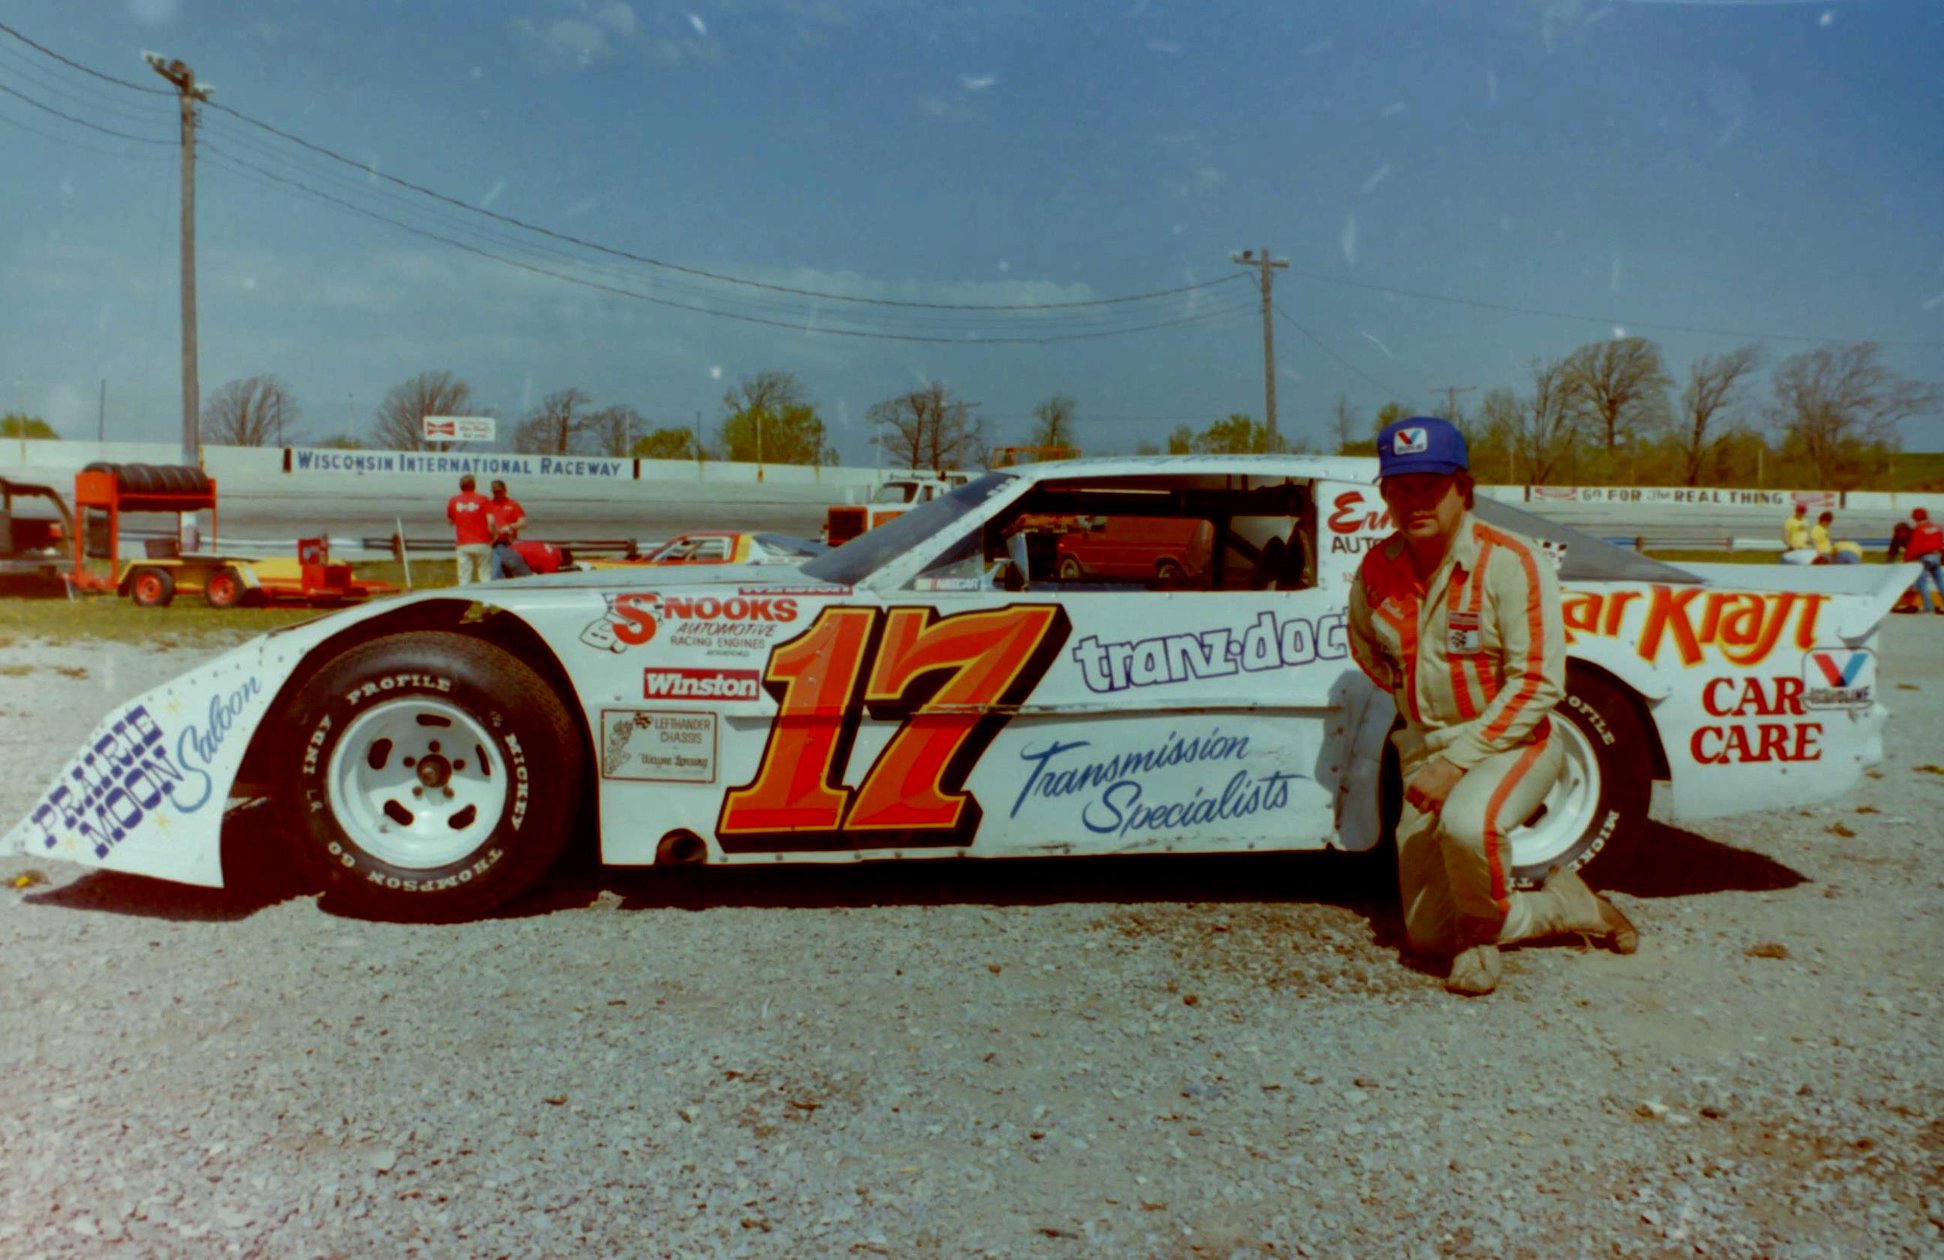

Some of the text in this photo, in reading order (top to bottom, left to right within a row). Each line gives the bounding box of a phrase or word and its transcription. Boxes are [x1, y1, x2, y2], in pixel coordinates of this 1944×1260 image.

[297, 451, 622, 477] WISCONSIN INTERNATIONAL RACEWAY
[1607, 489, 1642, 501] FOR
[1674, 490, 1721, 503] REAL
[1729, 491, 1784, 505] THING
[1331, 536, 1381, 554] AUT
[670, 635, 765, 649] RACING ENGINES
[1560, 583, 1833, 668] ar Kraft
[647, 671, 758, 696] Winston
[1702, 675, 1805, 717] CAR
[303, 674, 452, 775] INDY PROFILE
[655, 717, 711, 731] LEFTHANDER
[660, 731, 703, 744] CHASSIS
[716, 604, 1070, 852] 17
[1567, 695, 1616, 746] OFILE
[1689, 722, 1824, 765] CARE
[31, 704, 163, 849] PRAIRIE
[78, 676, 262, 860] MOON Saloon
[504, 732, 529, 831] MICKEY
[1010, 727, 1249, 819] Transmission
[1081, 769, 1312, 838] Specialists
[1567, 809, 1621, 872] MICKE
[366, 848, 503, 892] THOMPSON
